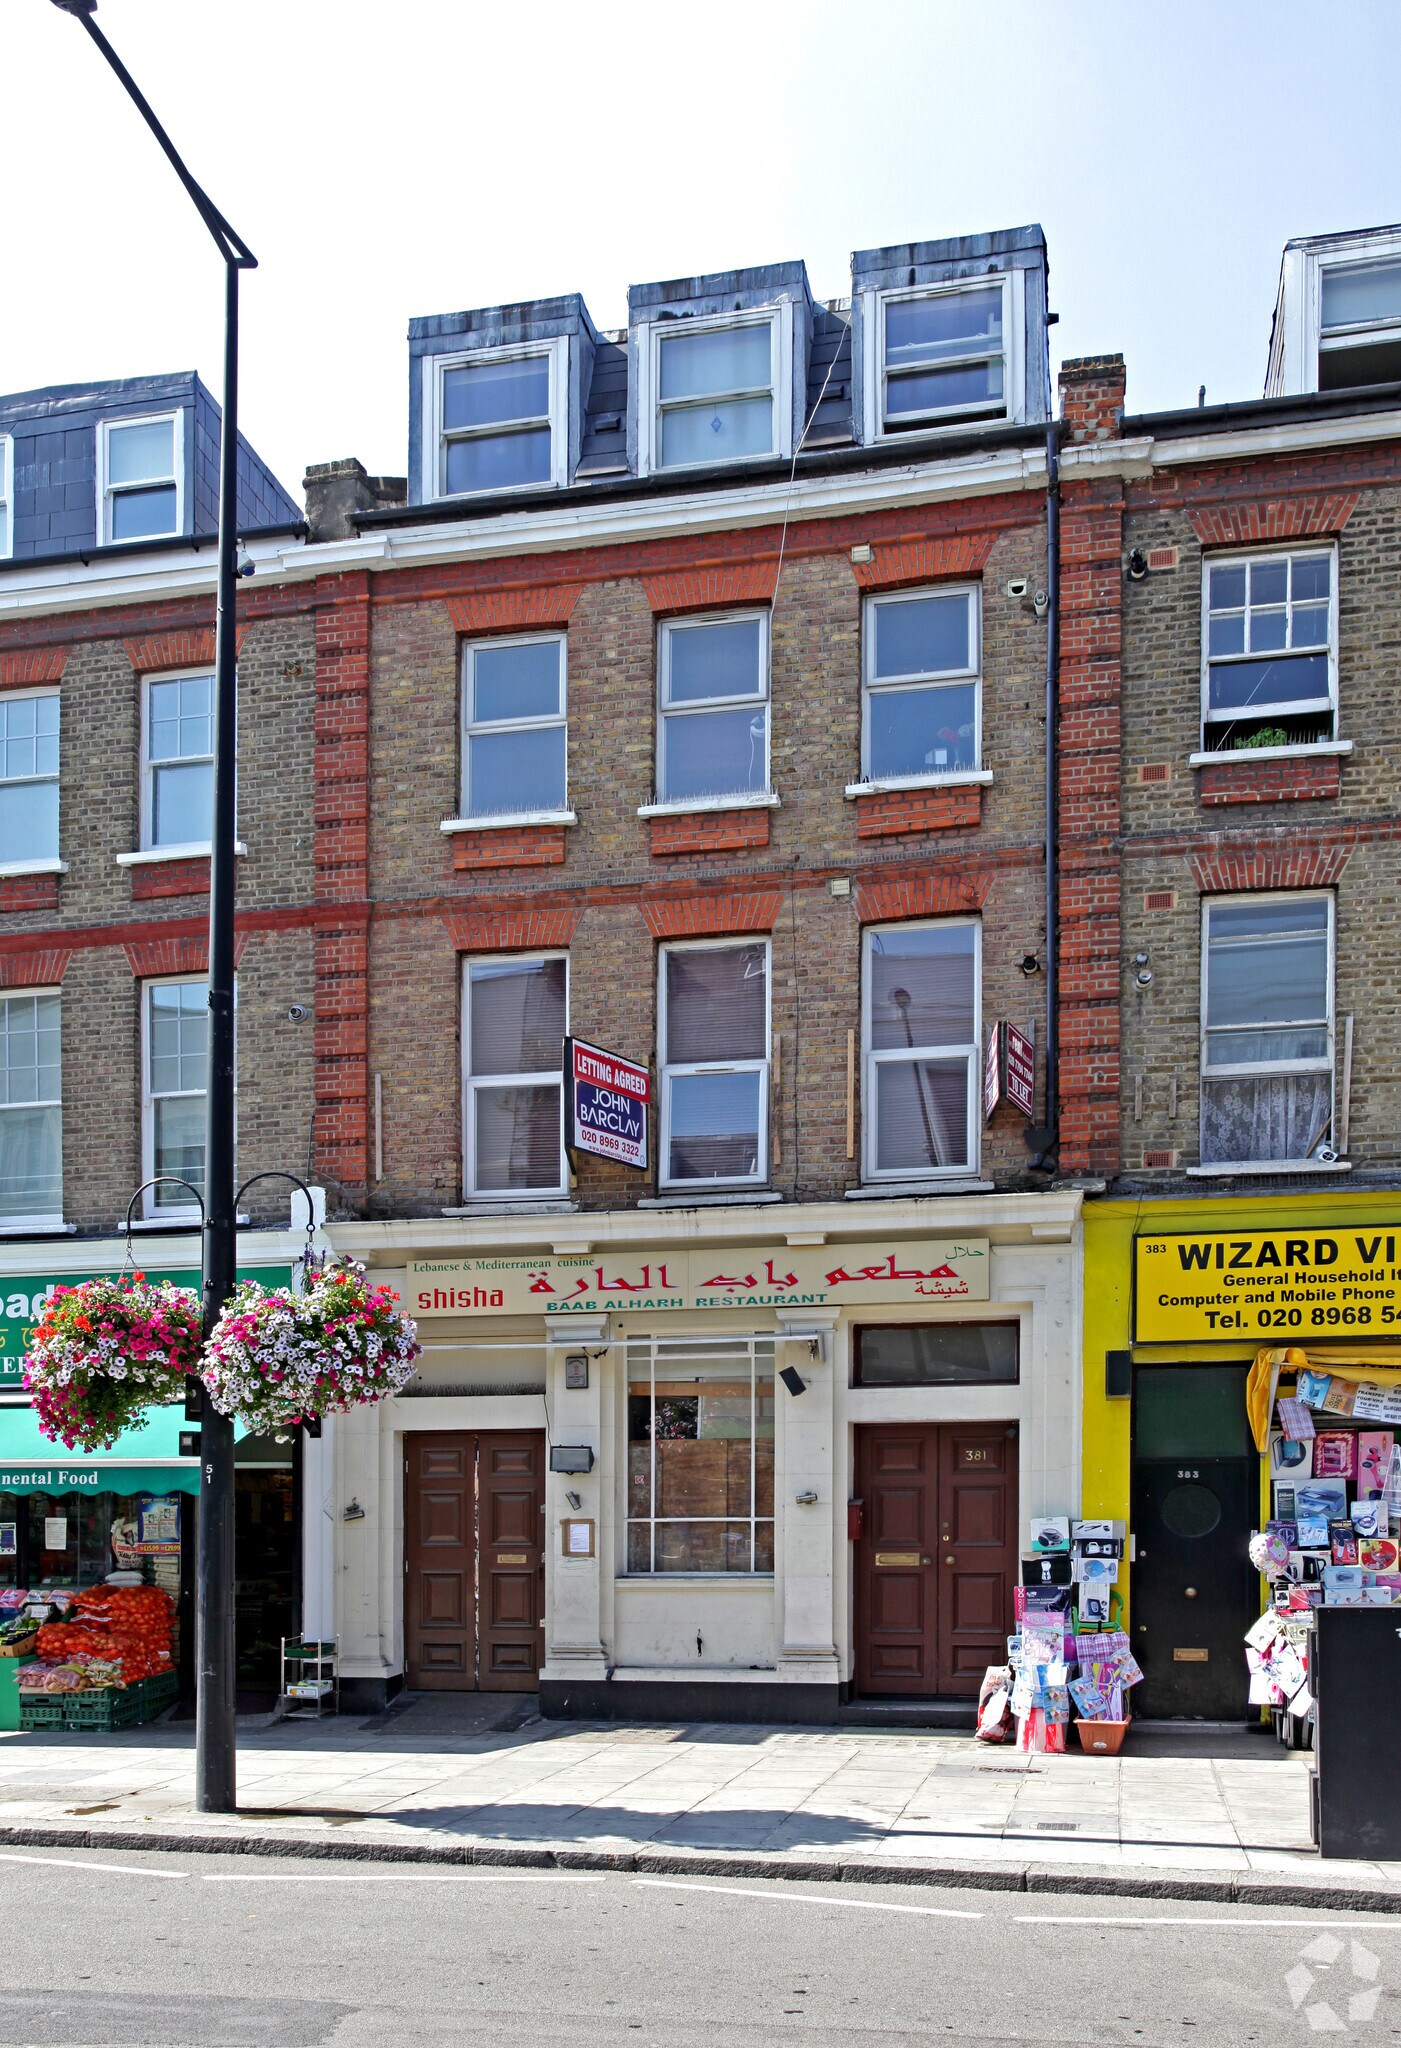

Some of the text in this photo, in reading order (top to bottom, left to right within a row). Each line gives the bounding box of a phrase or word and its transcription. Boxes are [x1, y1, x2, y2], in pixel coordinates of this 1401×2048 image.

[577, 1053, 646, 1096] LETTING AGREED
[1011, 1075, 1029, 1102] TO LET
[592, 1088, 630, 1115] JOHN
[580, 1103, 640, 1138] BARCLAY
[581, 1129, 639, 1157] 020 8969 3322
[946, 1246, 985, 1260] حلال
[1144, 1243, 1168, 1255] 383
[1176, 1238, 1339, 1271] WIZARD
[413, 1256, 595, 1273] Lebanese & Mediterranean cuisine
[823, 1252, 960, 1288] مطعم
[914, 1280, 969, 1299] شيشة
[1222, 1272, 1290, 1288] General
[1294, 1269, 1386, 1285] Household
[417, 1286, 504, 1311] shisha
[546, 1294, 829, 1312] BAAB ALHARH RESTAURANT
[1157, 1287, 1396, 1309] Computer and Mobile Phone
[1204, 1310, 1250, 1329] Tel.
[1256, 1308, 1304, 1328] 020
[1310, 1305, 1373, 1326] 8968
[965, 1450, 986, 1461] 381
[57, 1470, 98, 1485] Food
[1177, 1470, 1199, 1479] 383
